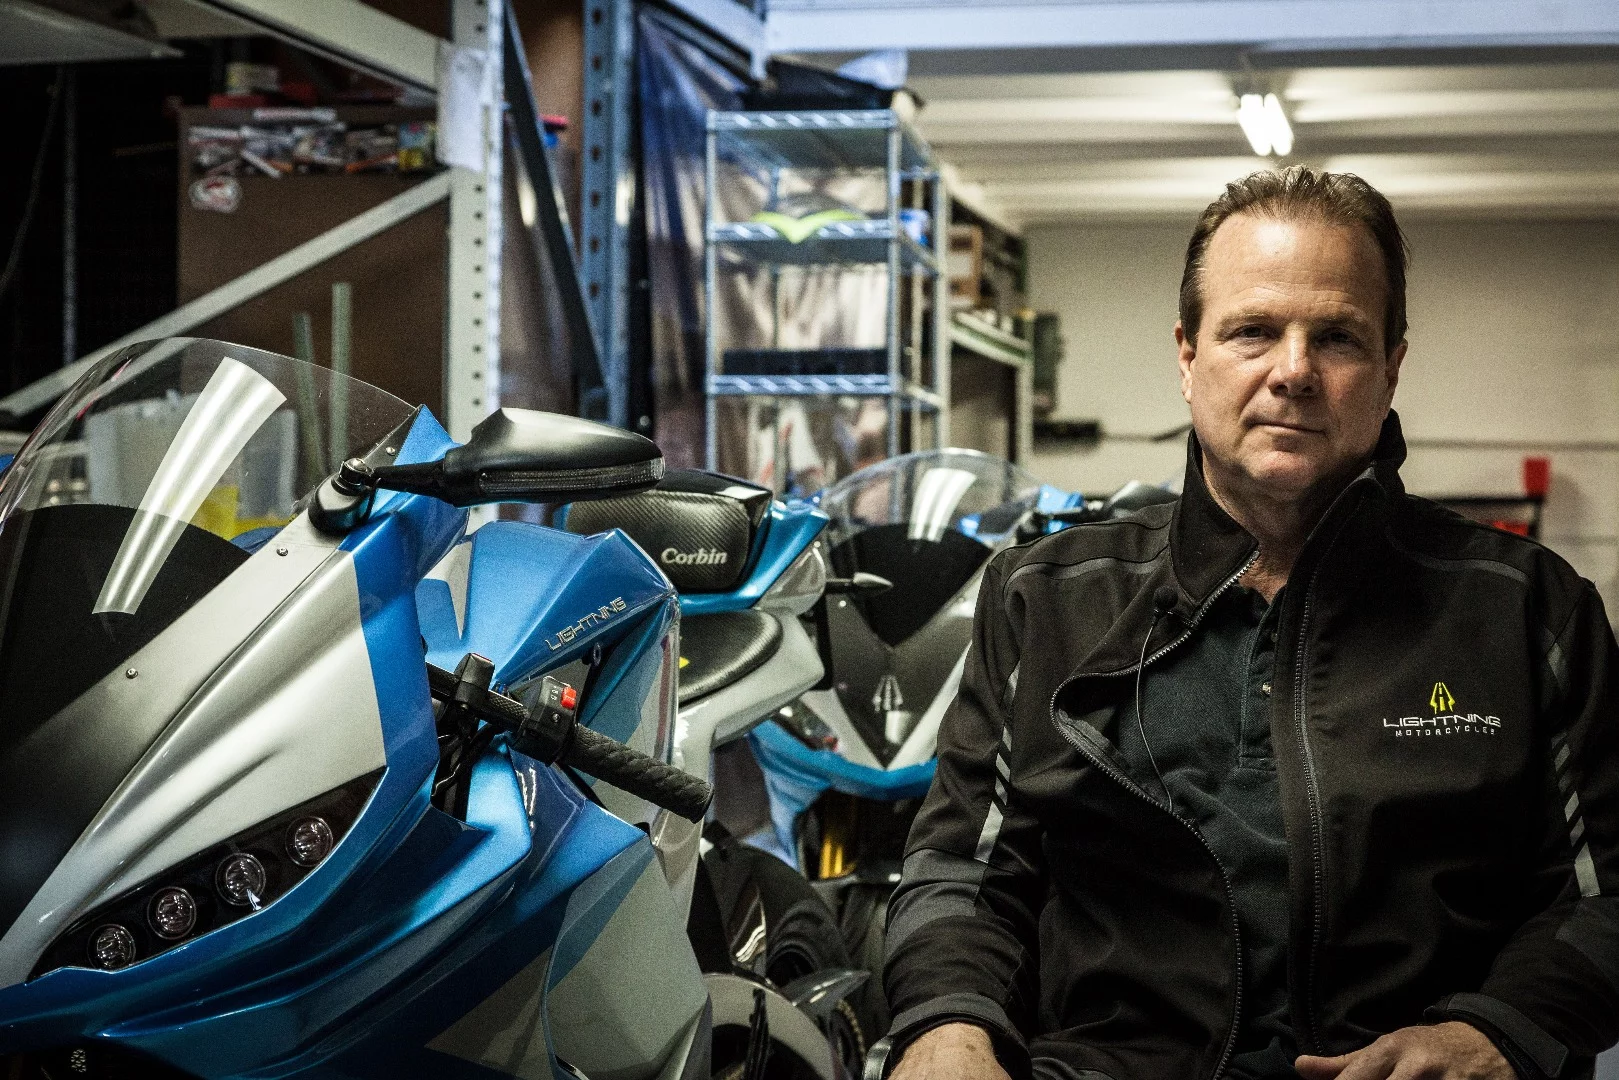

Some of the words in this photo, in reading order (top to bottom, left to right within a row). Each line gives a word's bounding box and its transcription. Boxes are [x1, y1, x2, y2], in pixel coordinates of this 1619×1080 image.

[661, 547, 727, 565] Corbin
[545, 596, 627, 651] LIGHTNING
[1383, 713, 1501, 728] LIGHTNING
[1395, 725, 1495, 737] MOTORCYCLES
